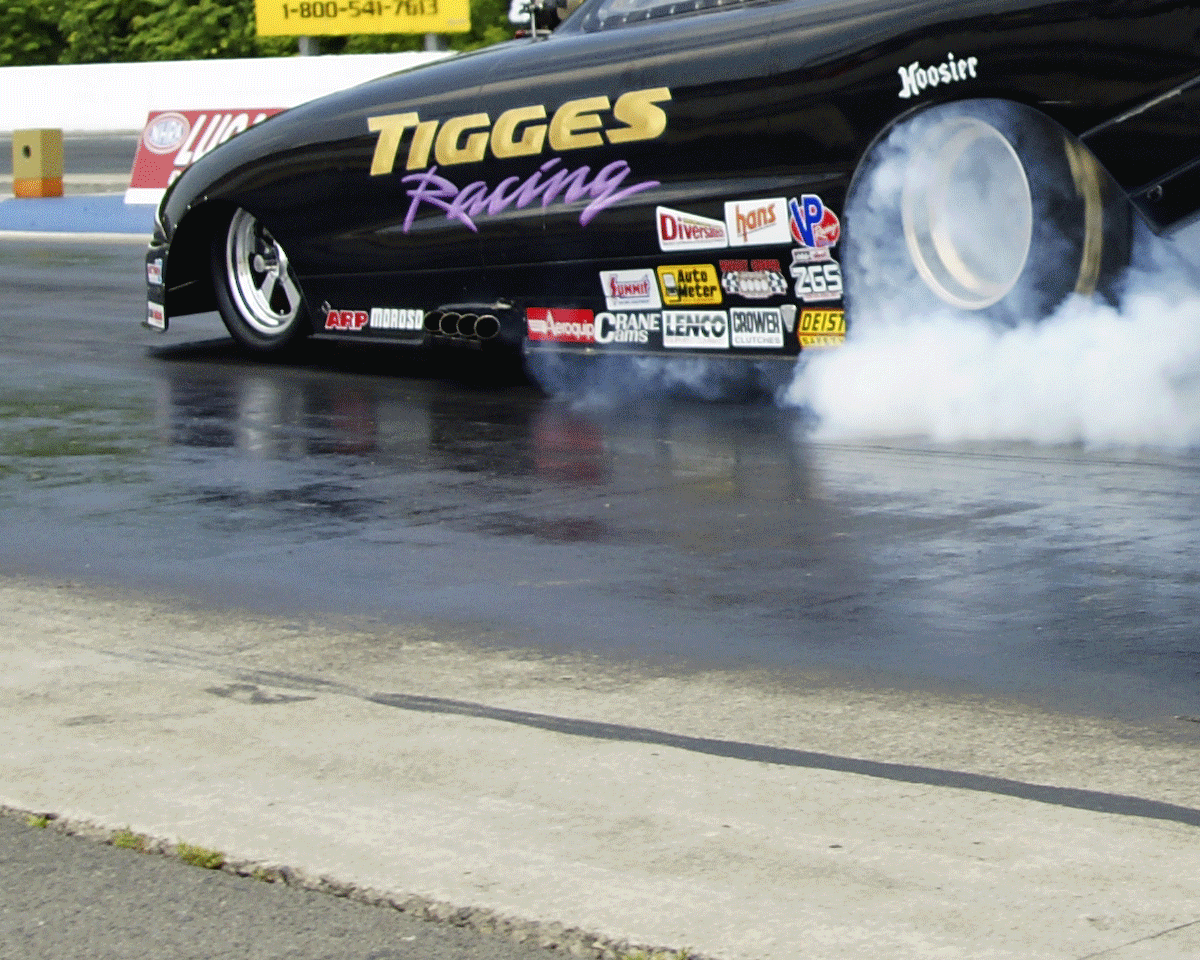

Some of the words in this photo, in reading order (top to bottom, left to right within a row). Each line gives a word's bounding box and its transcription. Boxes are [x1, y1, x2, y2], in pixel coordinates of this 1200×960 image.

[898, 52, 978, 98] Hoosier
[367, 87, 672, 176] TIGGES
[401, 157, 661, 234] Racing
[735, 204, 777, 243] hans
[677, 268, 708, 283] Auto
[677, 284, 718, 299] Meter
[325, 310, 369, 330] ARP
[370, 308, 424, 330] MOROSO
[666, 315, 725, 338] LENCO
[733, 311, 780, 334] CROWER
[735, 336, 780, 344] CLUTCHES
